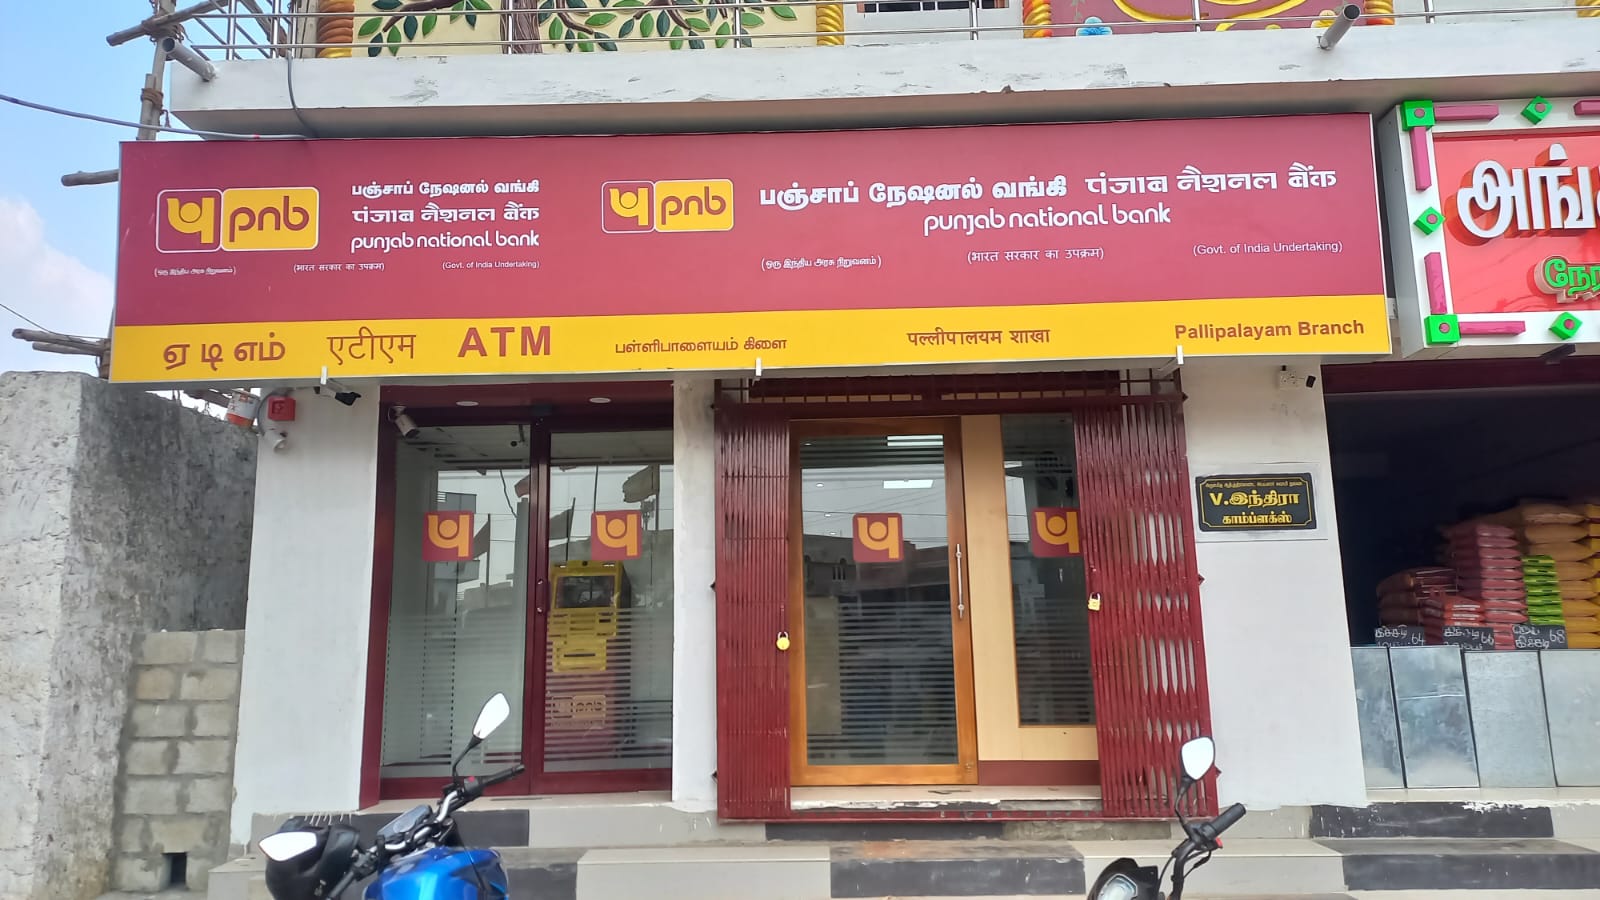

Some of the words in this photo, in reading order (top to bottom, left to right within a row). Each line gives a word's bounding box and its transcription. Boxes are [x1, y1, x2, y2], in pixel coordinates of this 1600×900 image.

[352, 181, 413, 198] பஞ்சாப்
[419, 180, 488, 197] நேஷனல்
[494, 179, 540, 194] வங்கி
[1085, 171, 1167, 194] पंजाब
[1177, 166, 1277, 192] नैशनल
[1288, 162, 1336, 187] बैंक
[760, 180, 858, 210] பஞ்சாப்
[869, 177, 982, 207] நேஷனல்
[992, 175, 1066, 198] வங்கி
[352, 207, 413, 222] पंजाब
[504, 201, 539, 220] बैंक
[661, 186, 726, 225] pnb
[229, 196, 309, 242] pnb
[925, 207, 1005, 236] punjab
[1009, 203, 1108, 227] national
[1111, 202, 1170, 224] bank
[352, 232, 414, 253] punjab
[416, 231, 492, 247] national
[496, 230, 539, 246] bank
[1193, 243, 1227, 257] (Govt.
[1229, 242, 1241, 254] of
[1242, 243, 1270, 254] India
[1273, 240, 1343, 253] Undertaking)
[442, 261, 465, 270] (Govt.
[466, 261, 474, 269] of
[494, 261, 540, 269] Undertaking)
[967, 250, 1000, 265] (भारत
[1003, 249, 1041, 261] सरकार
[458, 326, 550, 357] ATM
[1008, 329, 1051, 344] शाखा
[1175, 324, 1291, 341] Pallipalayam
[1299, 320, 1364, 335] Branch
[164, 344, 190, 370] ஏ
[201, 344, 223, 371] டி
[234, 332, 285, 361] எம்
[326, 326, 417, 365] एटीएम
[743, 336, 788, 351] கிளை
